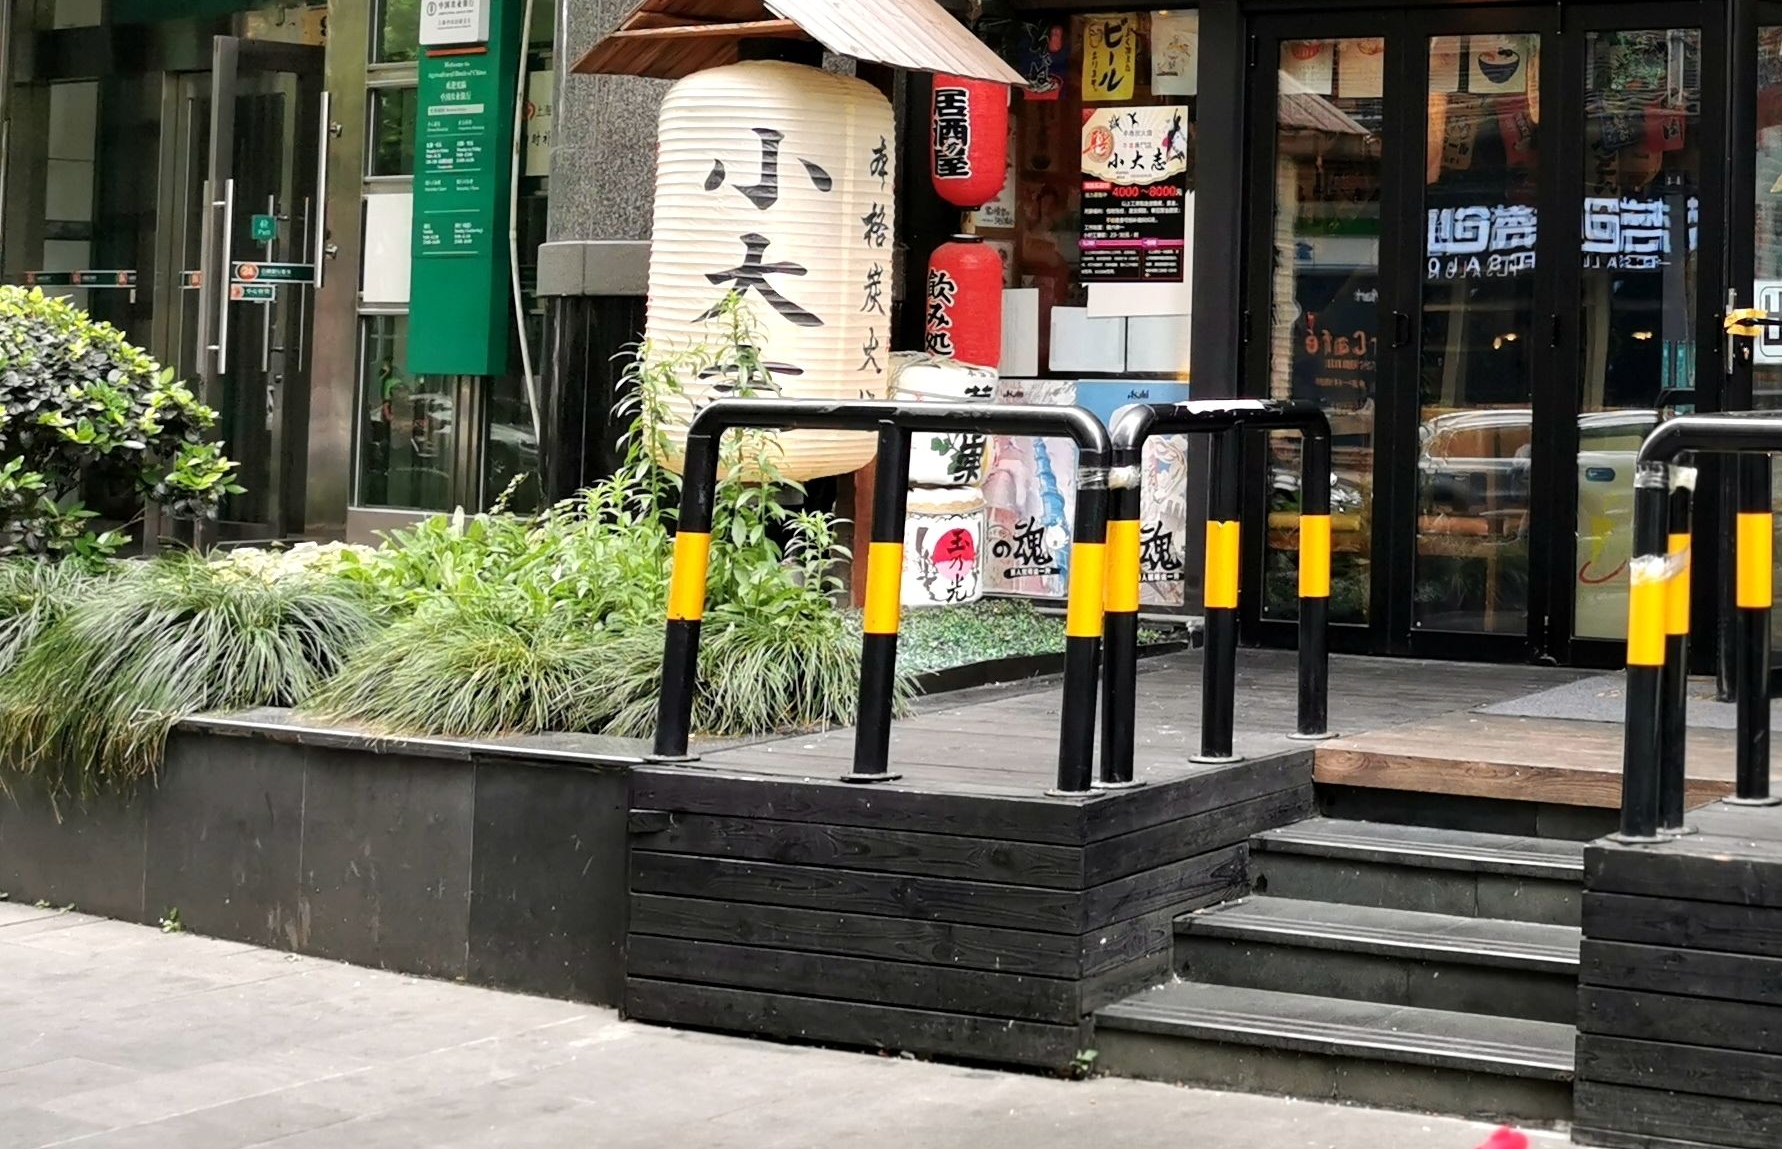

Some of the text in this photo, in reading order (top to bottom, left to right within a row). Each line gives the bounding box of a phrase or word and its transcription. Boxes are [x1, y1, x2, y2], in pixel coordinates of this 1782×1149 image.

[1099, 17, 1134, 92] ビール
[933, 88, 970, 178] 居酒屋
[860, 135, 890, 400] 本格炭火
[925, 269, 956, 356] 飲み処
[947, 530, 970, 603] 玉乃光
